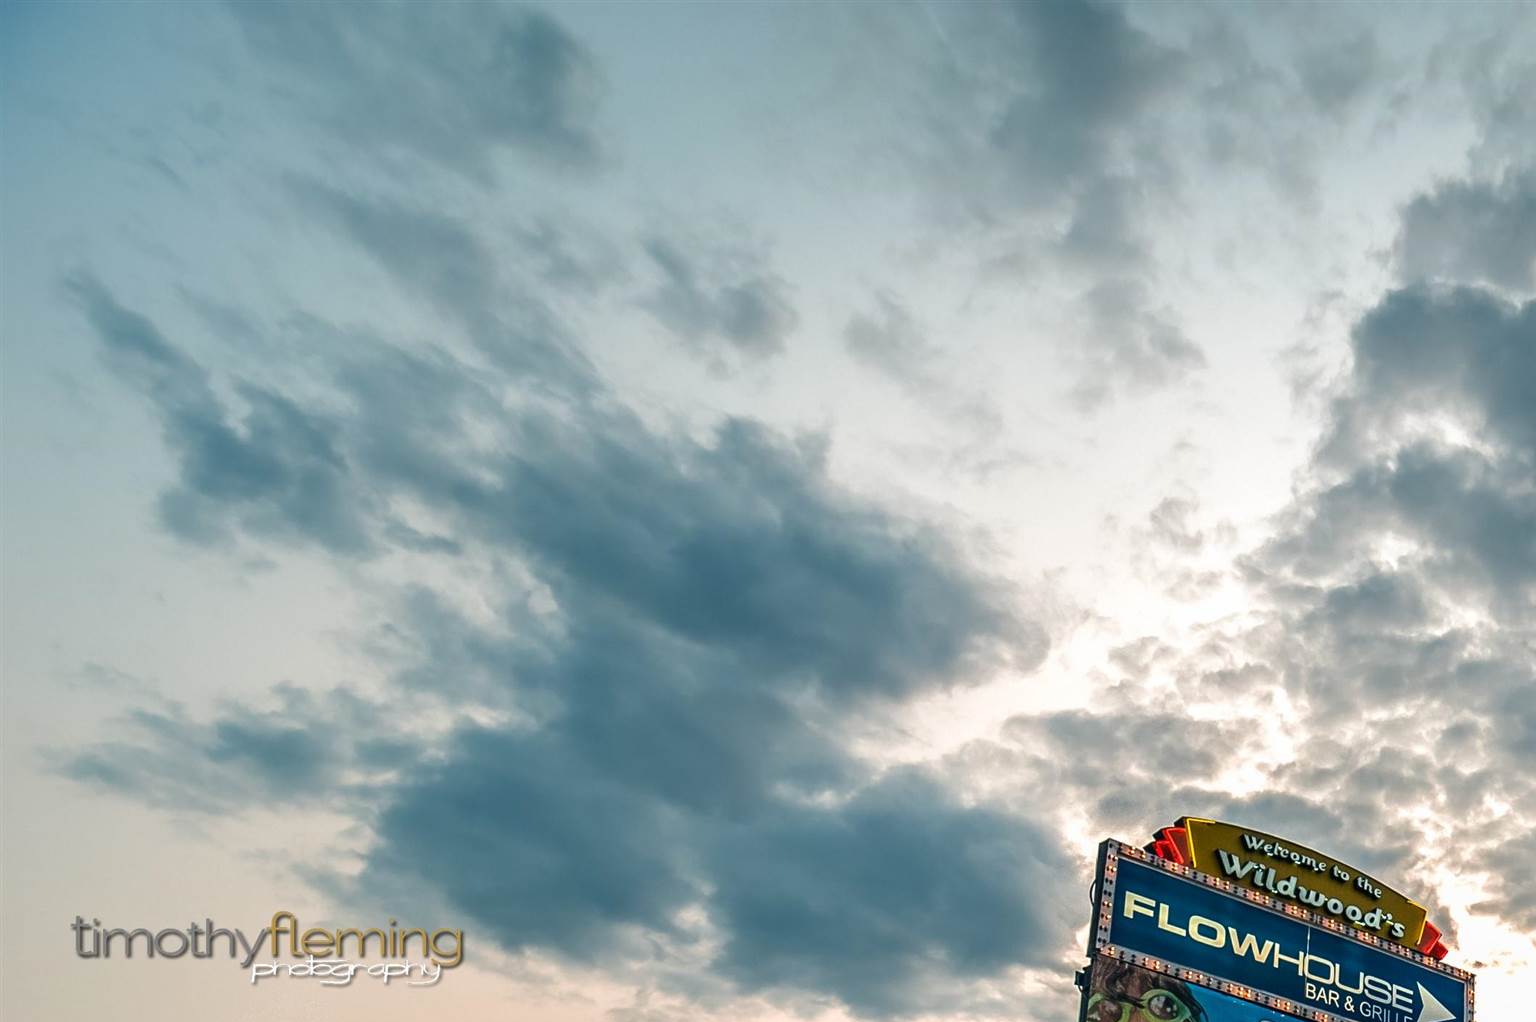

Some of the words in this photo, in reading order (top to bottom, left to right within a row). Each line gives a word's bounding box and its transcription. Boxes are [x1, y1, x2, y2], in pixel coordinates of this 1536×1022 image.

[1242, 833, 1328, 871] Welcome
[1333, 865, 1350, 881] to
[1357, 876, 1382, 899] the
[1123, 890, 1414, 1014] FLOWHOUSE
[1305, 982, 1340, 1010] BAR
[1344, 995, 1356, 1013] &
